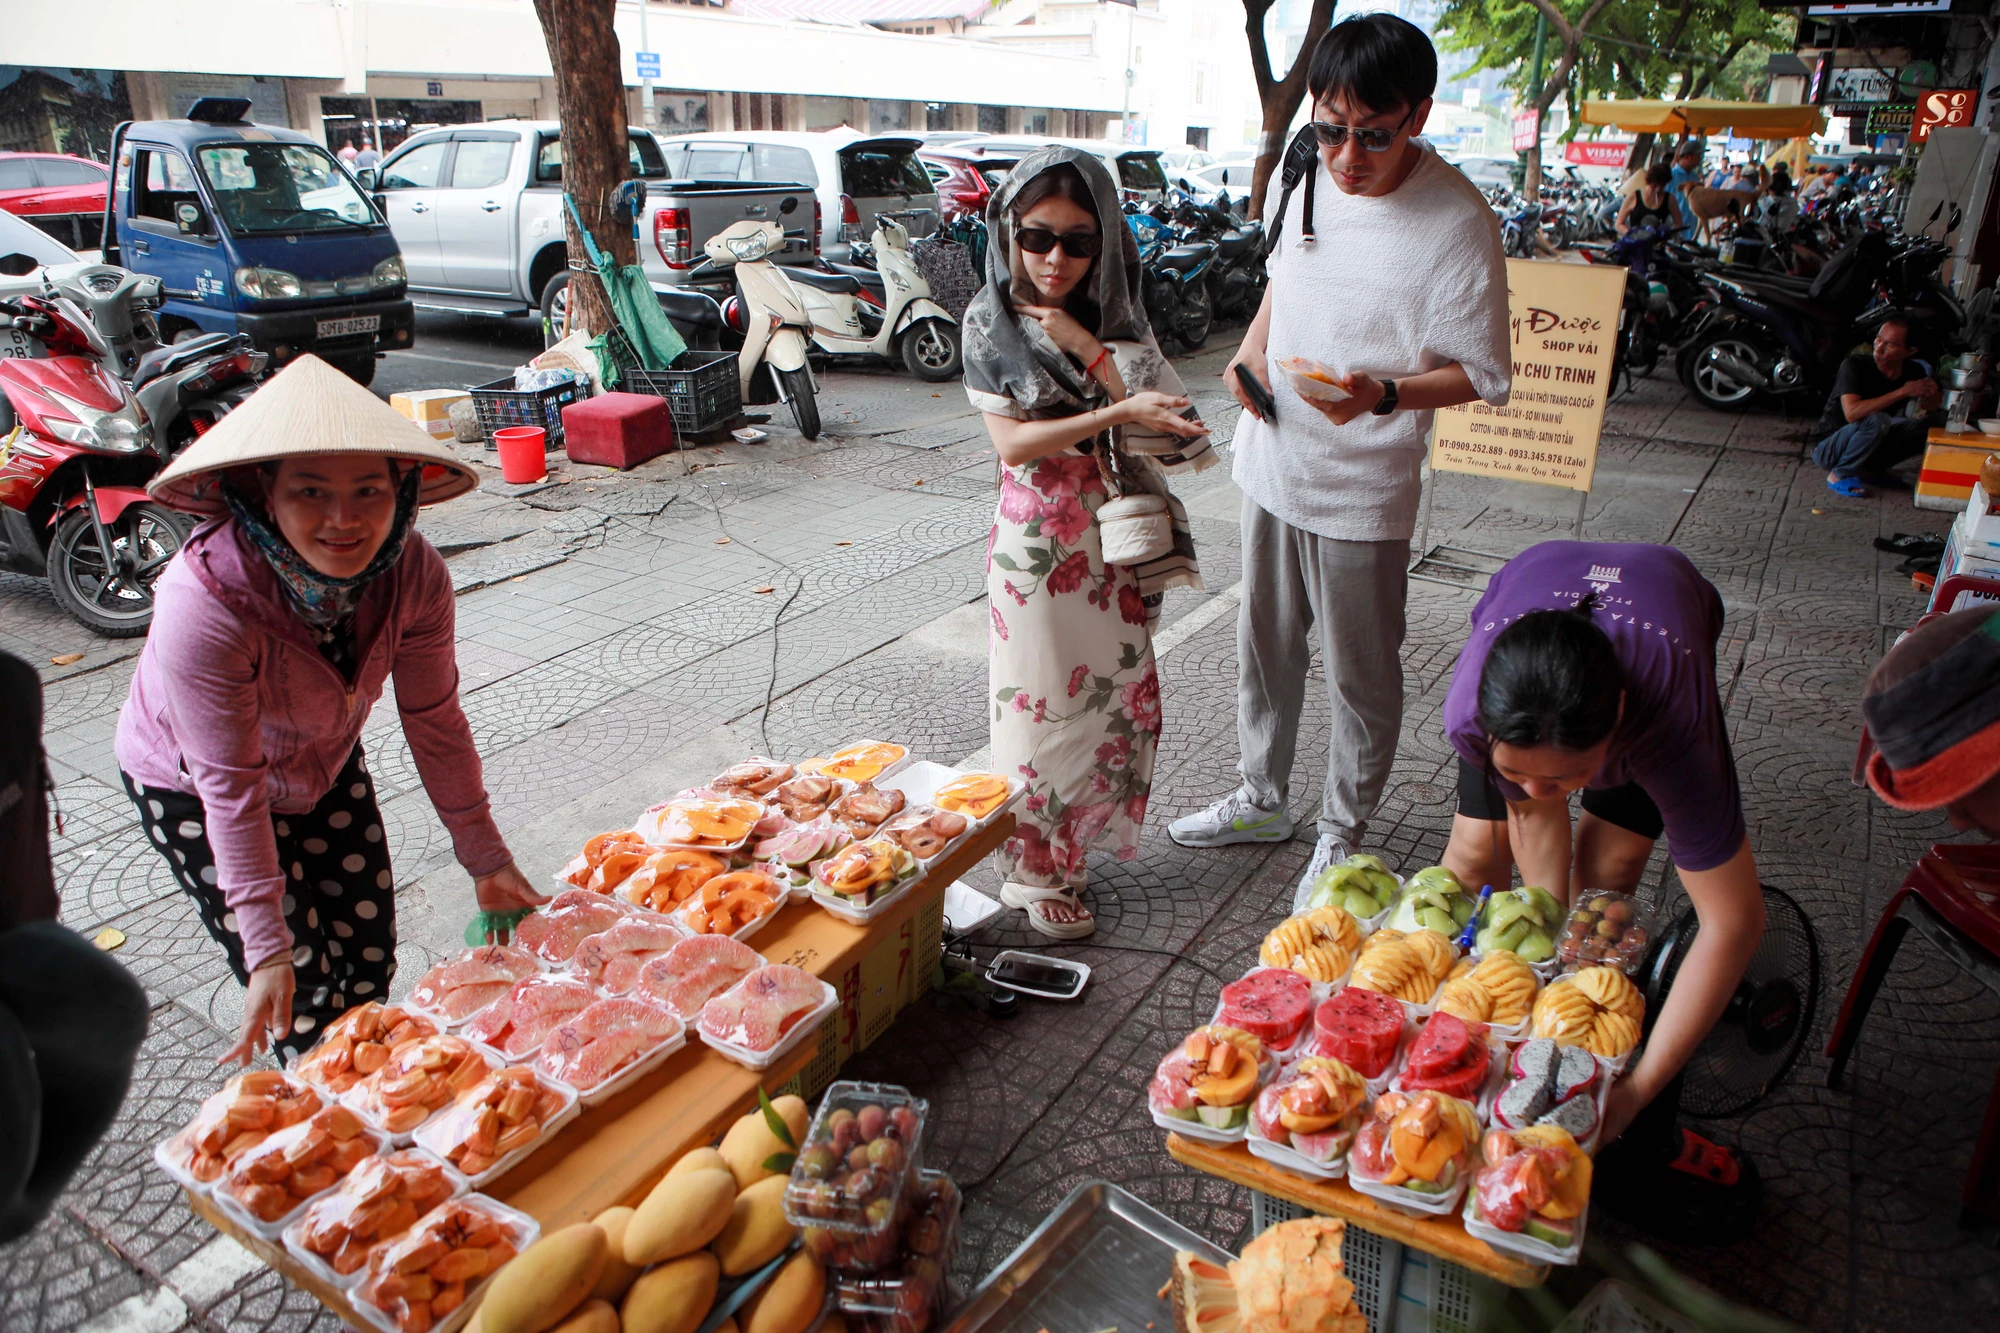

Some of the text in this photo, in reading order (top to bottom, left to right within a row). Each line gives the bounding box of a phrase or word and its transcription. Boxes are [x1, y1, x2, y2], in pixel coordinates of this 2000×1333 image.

[1525, 307, 1601, 334] Được
[1542, 340, 1598, 355] SHOP VẢI
[1524, 363, 1551, 380] CHU
[1555, 366, 1596, 385] TRINH
[1550, 393, 1567, 406] TRANG
[1569, 396, 1581, 408] CAO
[1582, 394, 1594, 409] CẤP
[1473, 404, 1492, 416] VESTON
[1541, 413, 1554, 423] NAM
[1470, 422, 1491, 434] COTTON
[1494, 426, 1509, 437] LINEN
[1512, 428, 1522, 439] REN
[1539, 431, 1553, 442] SATIN
[19, 458, 45, 470] HONDA
[1508, 448, 1562, 464] 0933.345.978
[1563, 456, 1586, 468] (Zalo)
